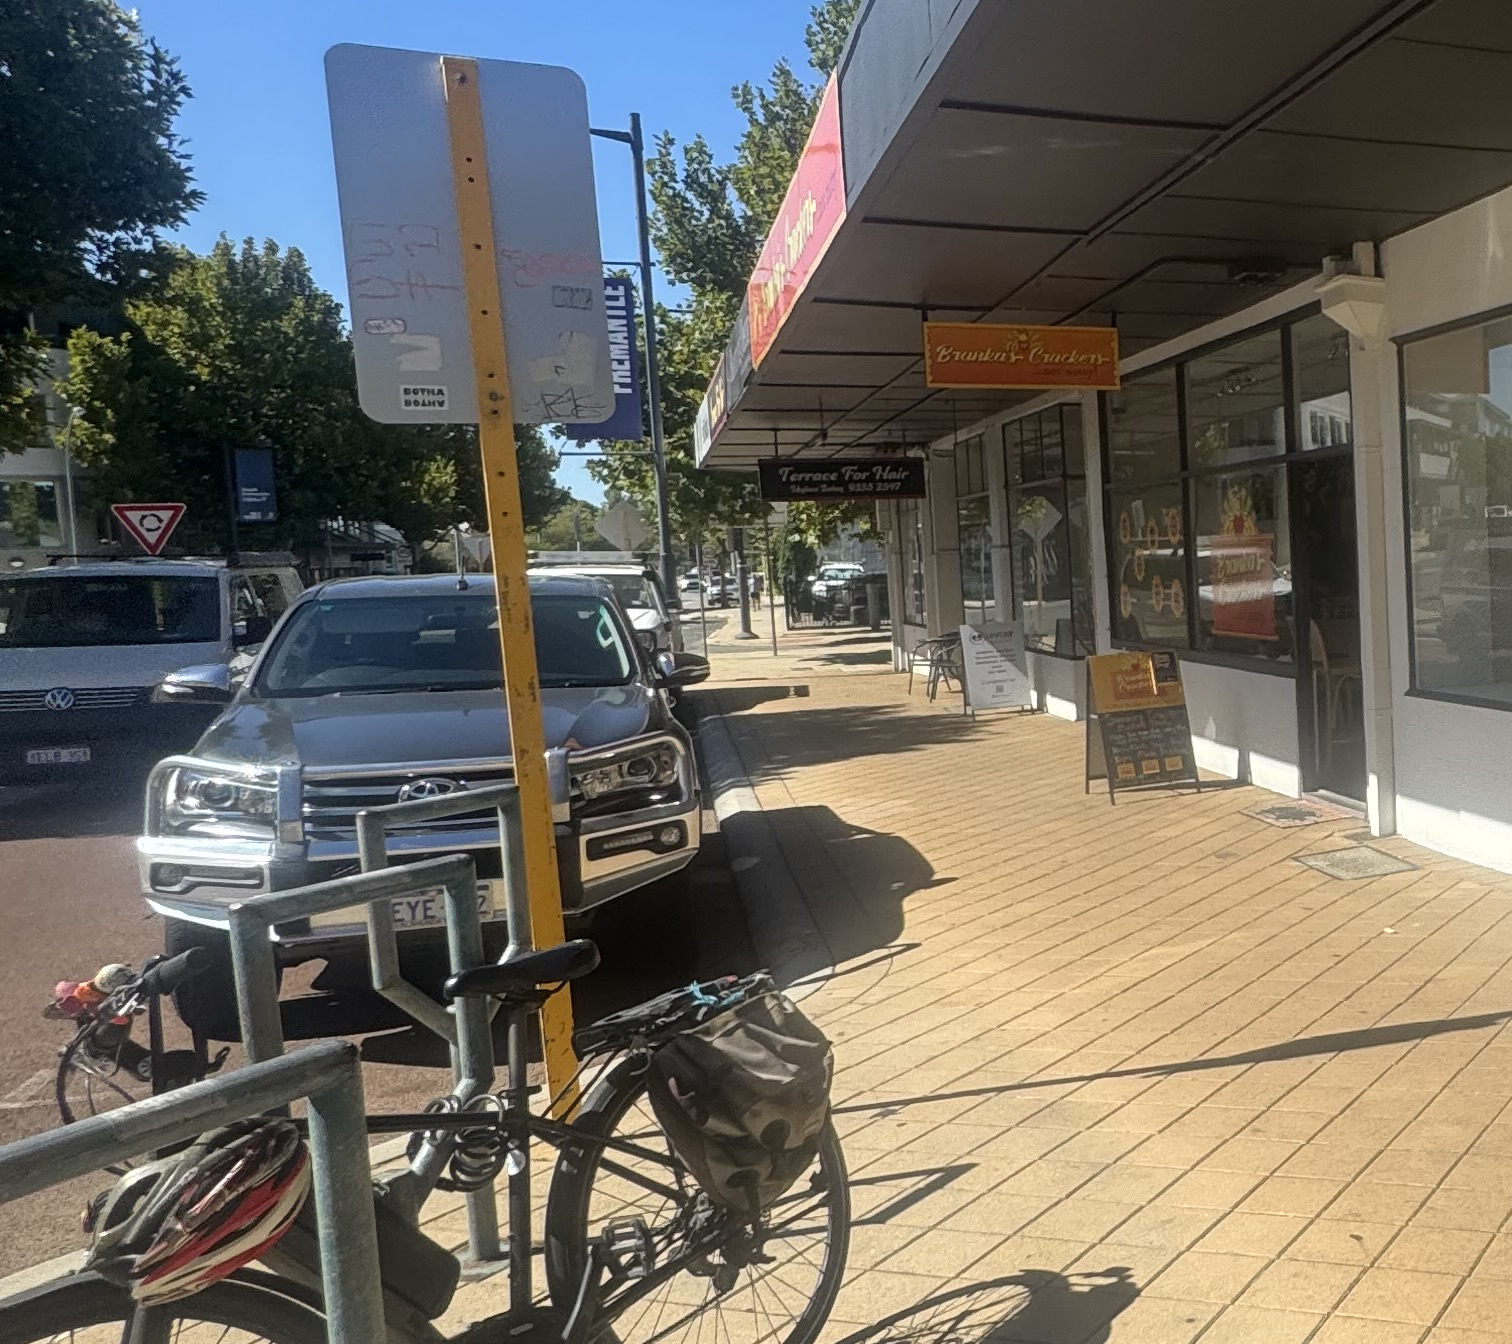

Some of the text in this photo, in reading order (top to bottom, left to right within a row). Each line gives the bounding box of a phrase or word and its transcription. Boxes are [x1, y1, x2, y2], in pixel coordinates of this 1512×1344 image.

[1028, 347, 1110, 365] Crackers
[404, 388, 445, 396] BOTHA
[778, 466, 910, 482] Terrace For Hair
